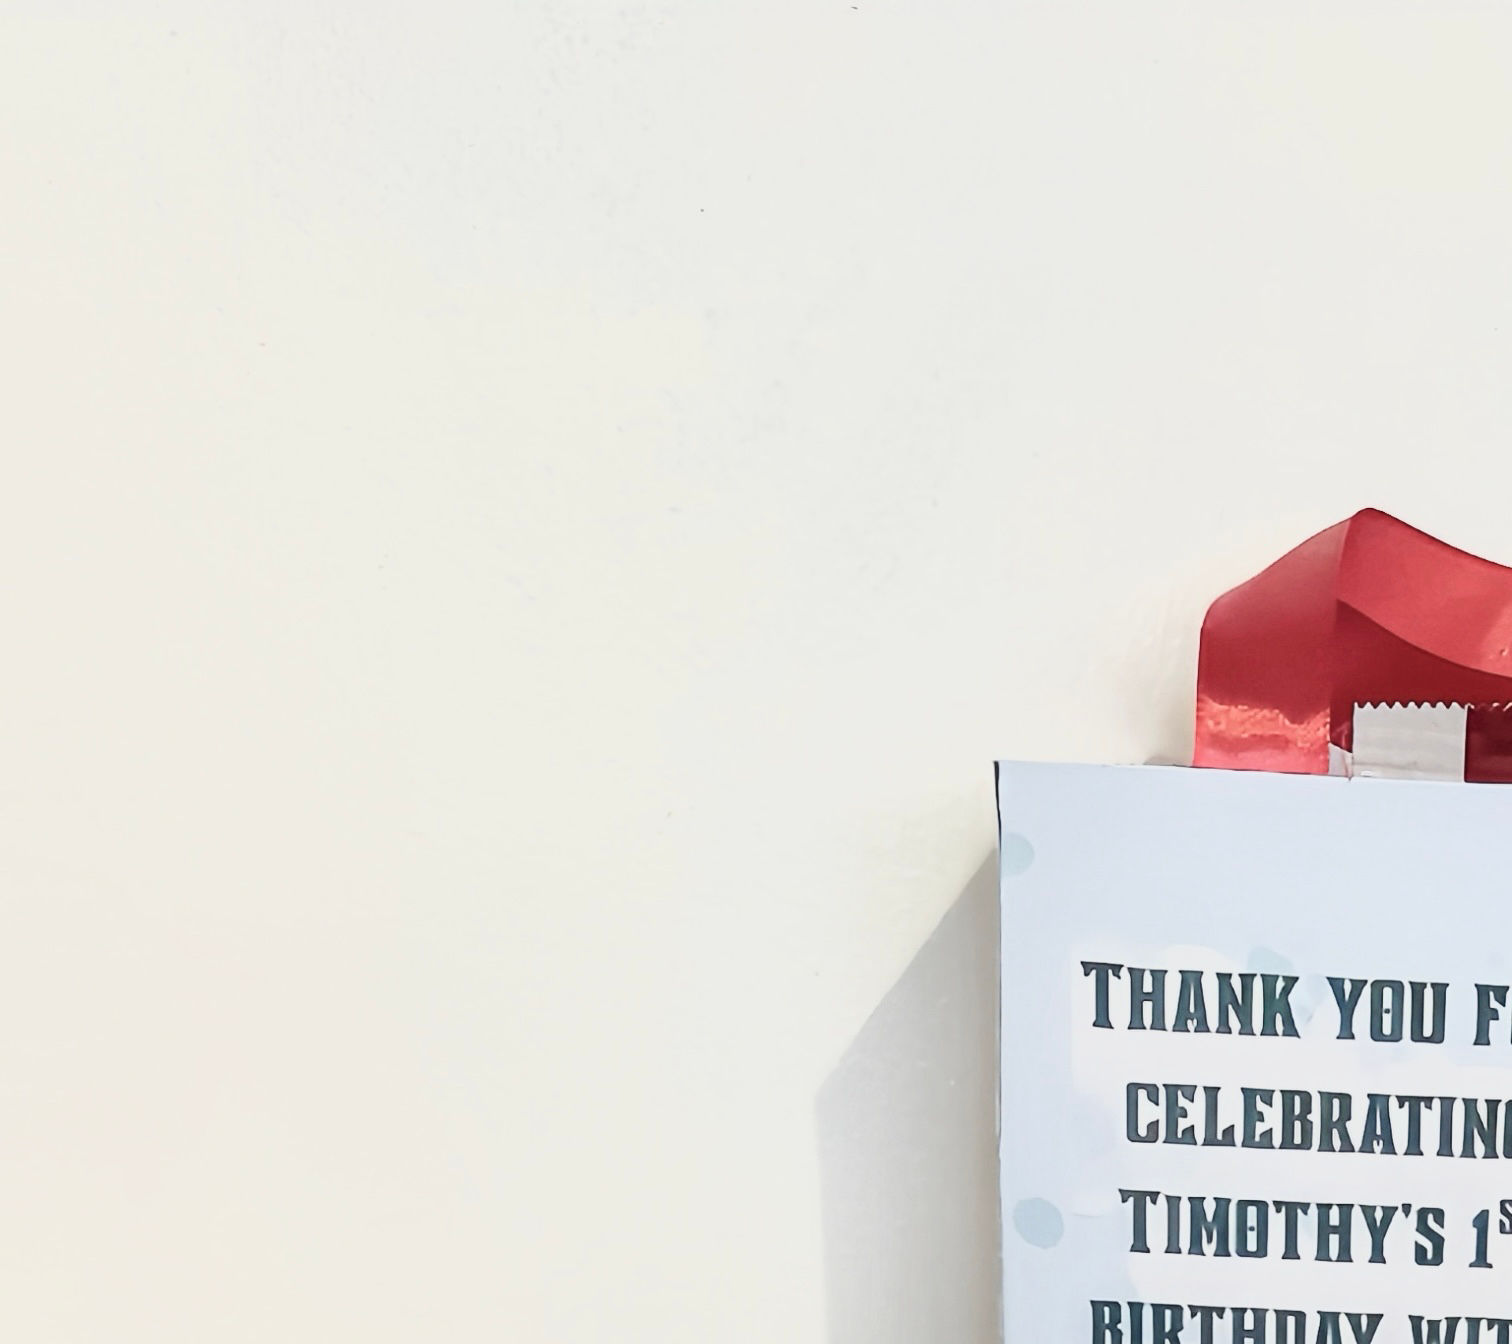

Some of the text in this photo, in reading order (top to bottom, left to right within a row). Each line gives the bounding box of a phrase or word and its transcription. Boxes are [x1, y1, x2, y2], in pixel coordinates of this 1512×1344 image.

[1081, 961, 1300, 1039] THANK
[1326, 976, 1450, 1045] YOU
[1118, 1188, 1446, 1267] TIMOTHY'S
